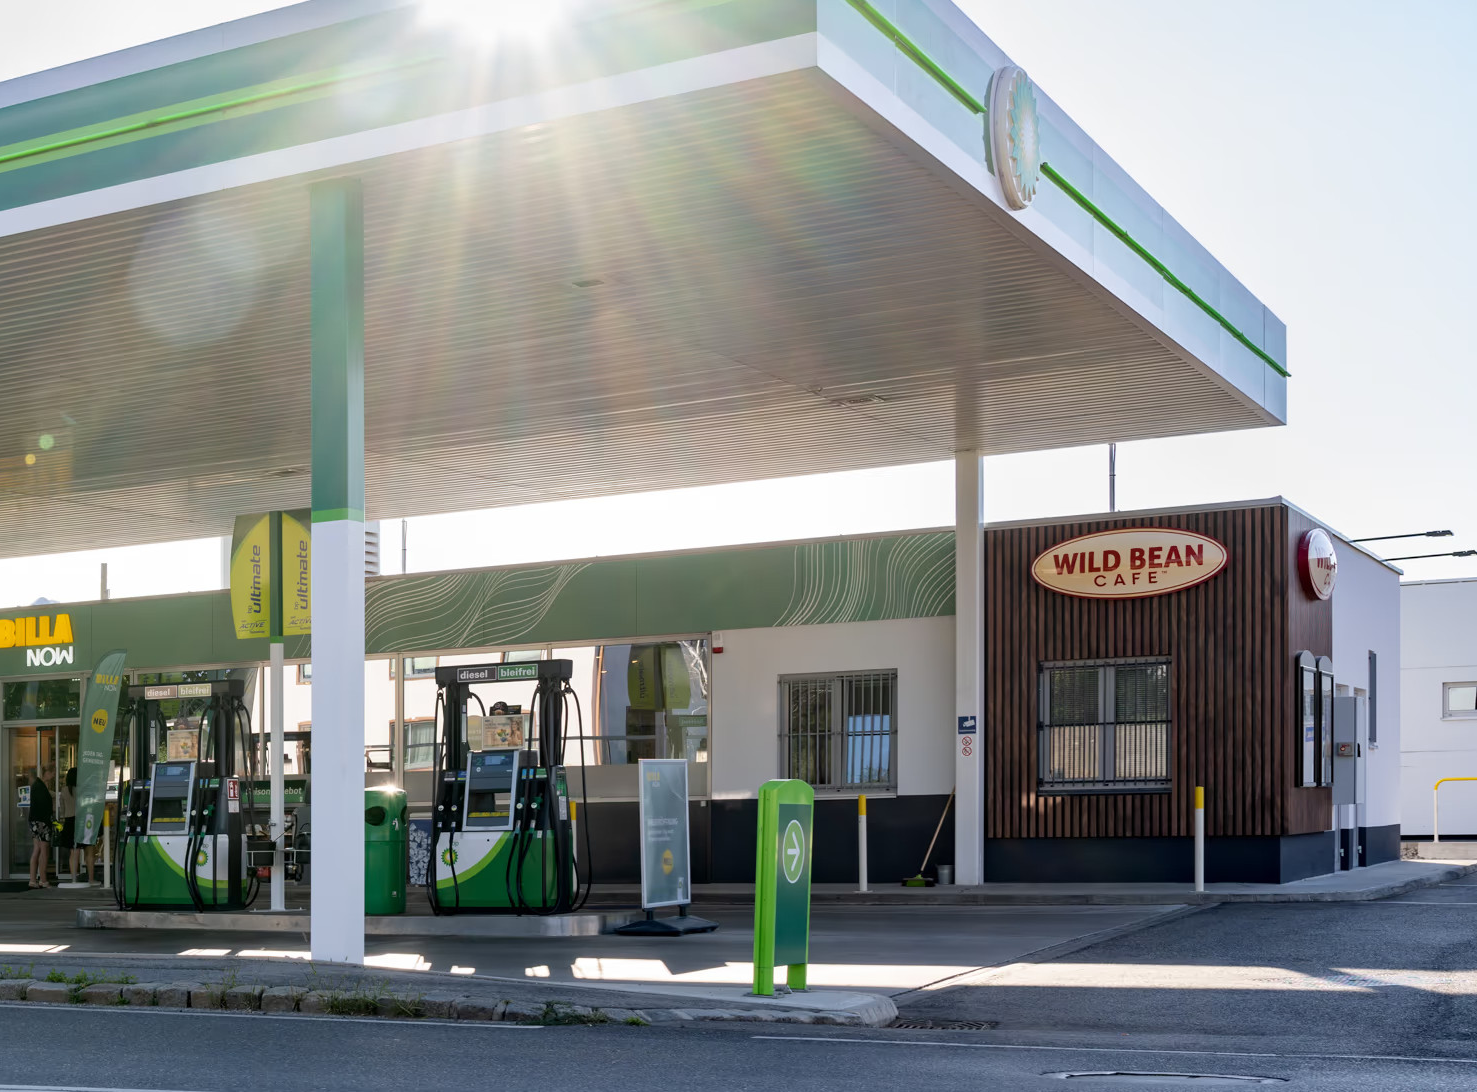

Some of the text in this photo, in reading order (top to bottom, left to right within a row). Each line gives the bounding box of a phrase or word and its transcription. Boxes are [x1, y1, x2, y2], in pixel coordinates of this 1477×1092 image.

[1053, 544, 1203, 575] WILD BEAN
[250, 545, 261, 613] ultimate
[297, 541, 308, 610] ultimate
[1094, 571, 1158, 587] CAFE
[27, 646, 74, 667] NOW
[460, 669, 488, 679] diesel
[500, 667, 535, 677] bleifrei
[147, 688, 170, 696] diesel
[180, 686, 209, 696] bleifrei
